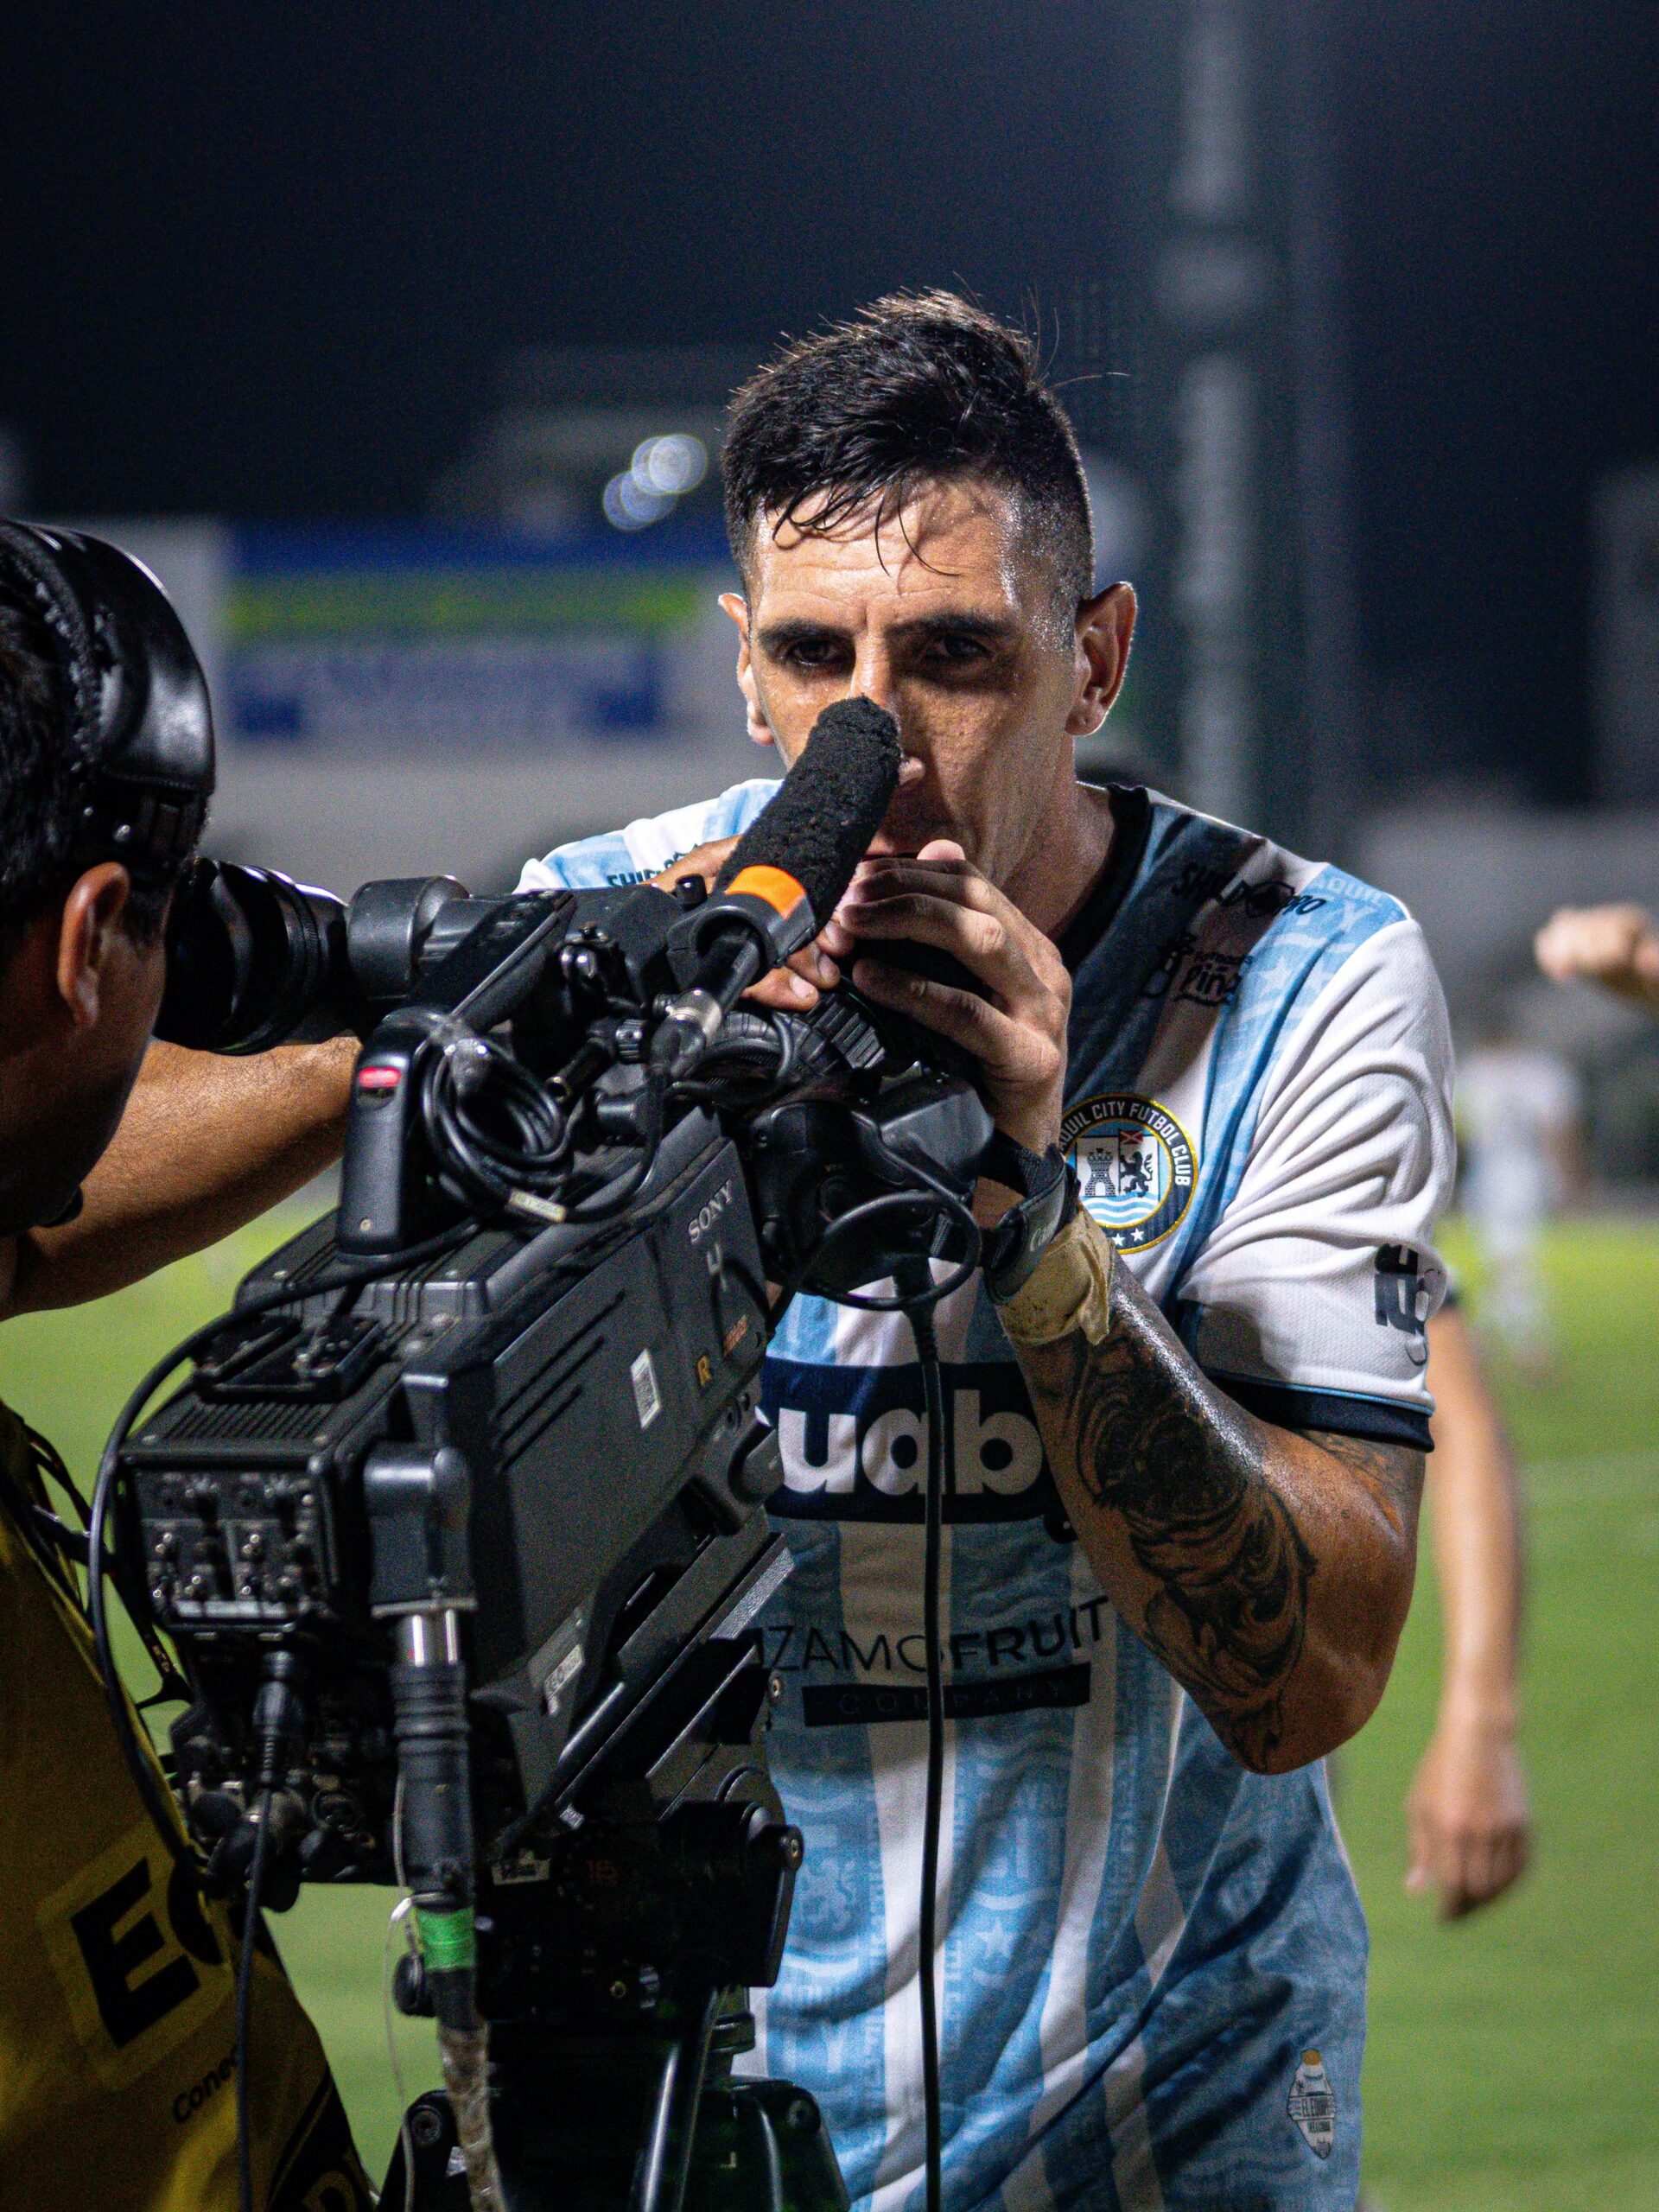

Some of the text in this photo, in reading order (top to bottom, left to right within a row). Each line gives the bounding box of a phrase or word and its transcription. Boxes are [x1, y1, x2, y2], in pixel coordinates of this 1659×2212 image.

[1091, 1100, 1126, 1121] CITY
[1128, 1102, 1180, 1146] FUTBOL
[1171, 1143, 1192, 1187] CLUB
[688, 1179, 733, 1243] SONY
[779, 1388, 1044, 1497] uab
